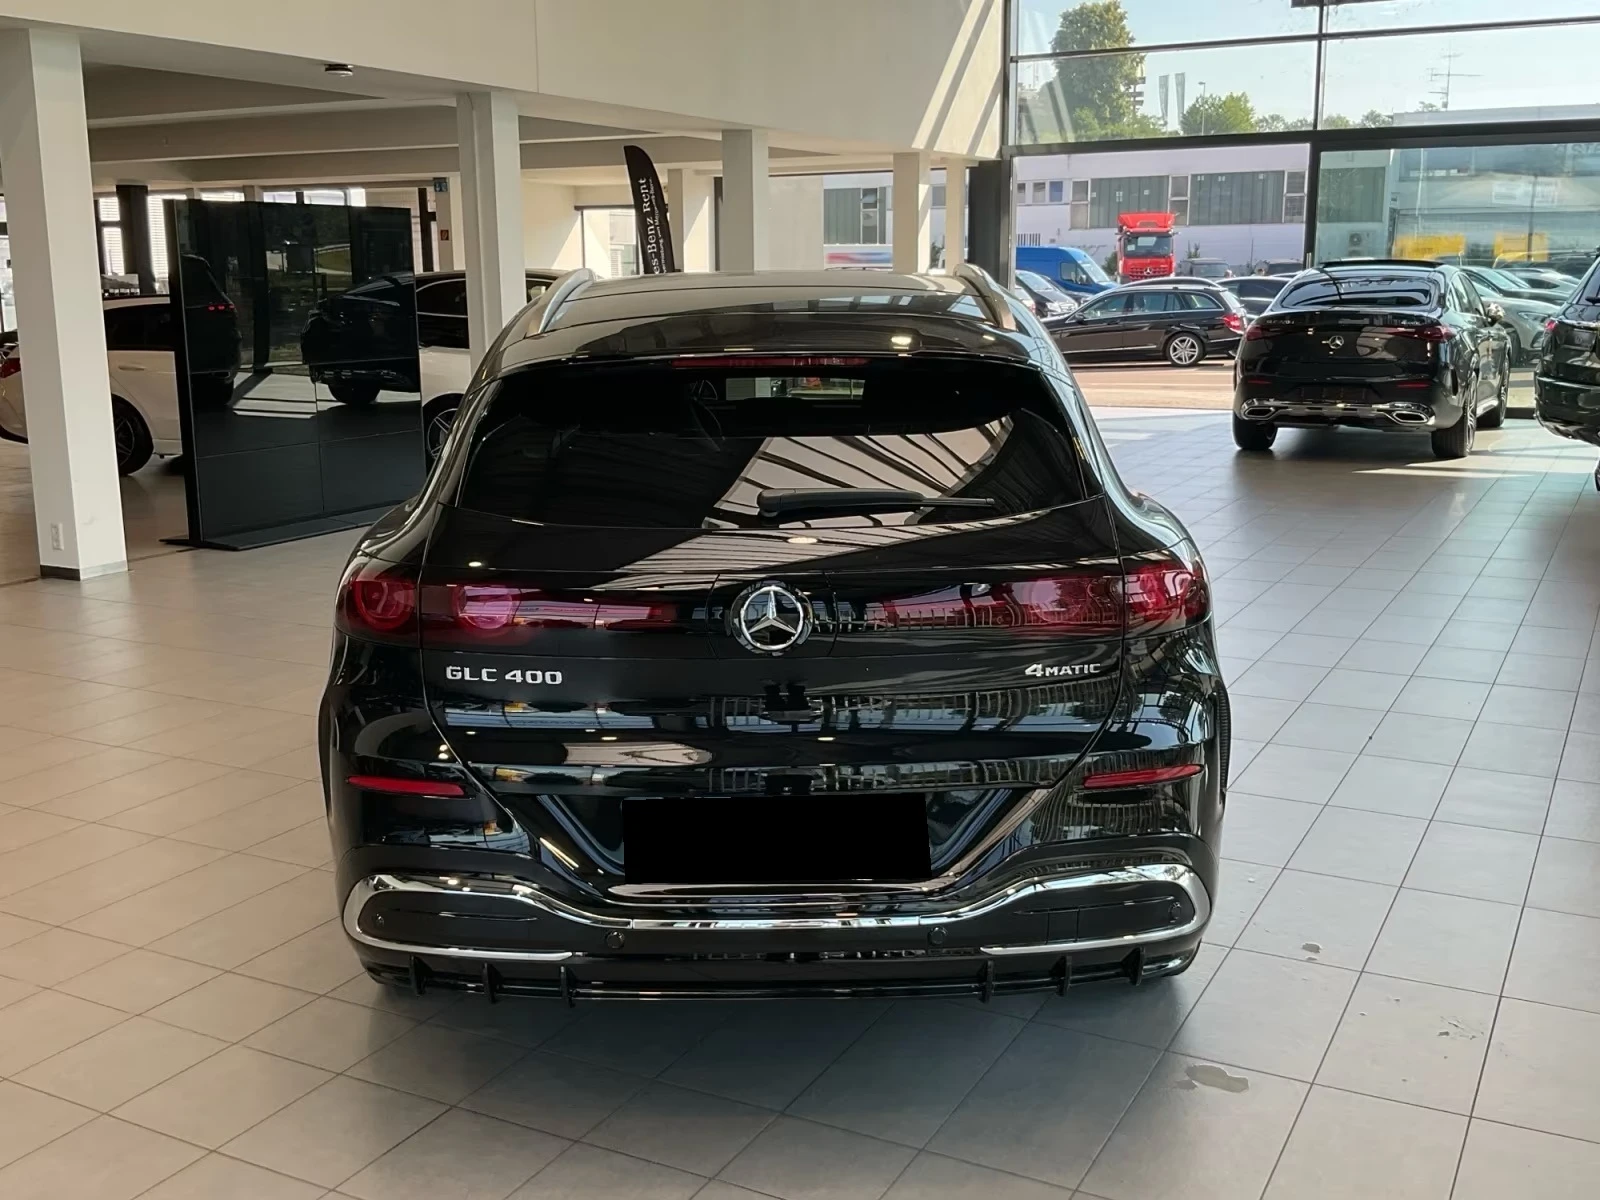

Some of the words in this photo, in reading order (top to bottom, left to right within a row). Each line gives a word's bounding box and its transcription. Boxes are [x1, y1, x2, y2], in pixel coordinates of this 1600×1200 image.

[638, 177, 651, 213] Rent
[446, 665, 498, 682] GLC
[504, 669, 563, 685] 400
[1024, 663, 1101, 677] 4MATIC
